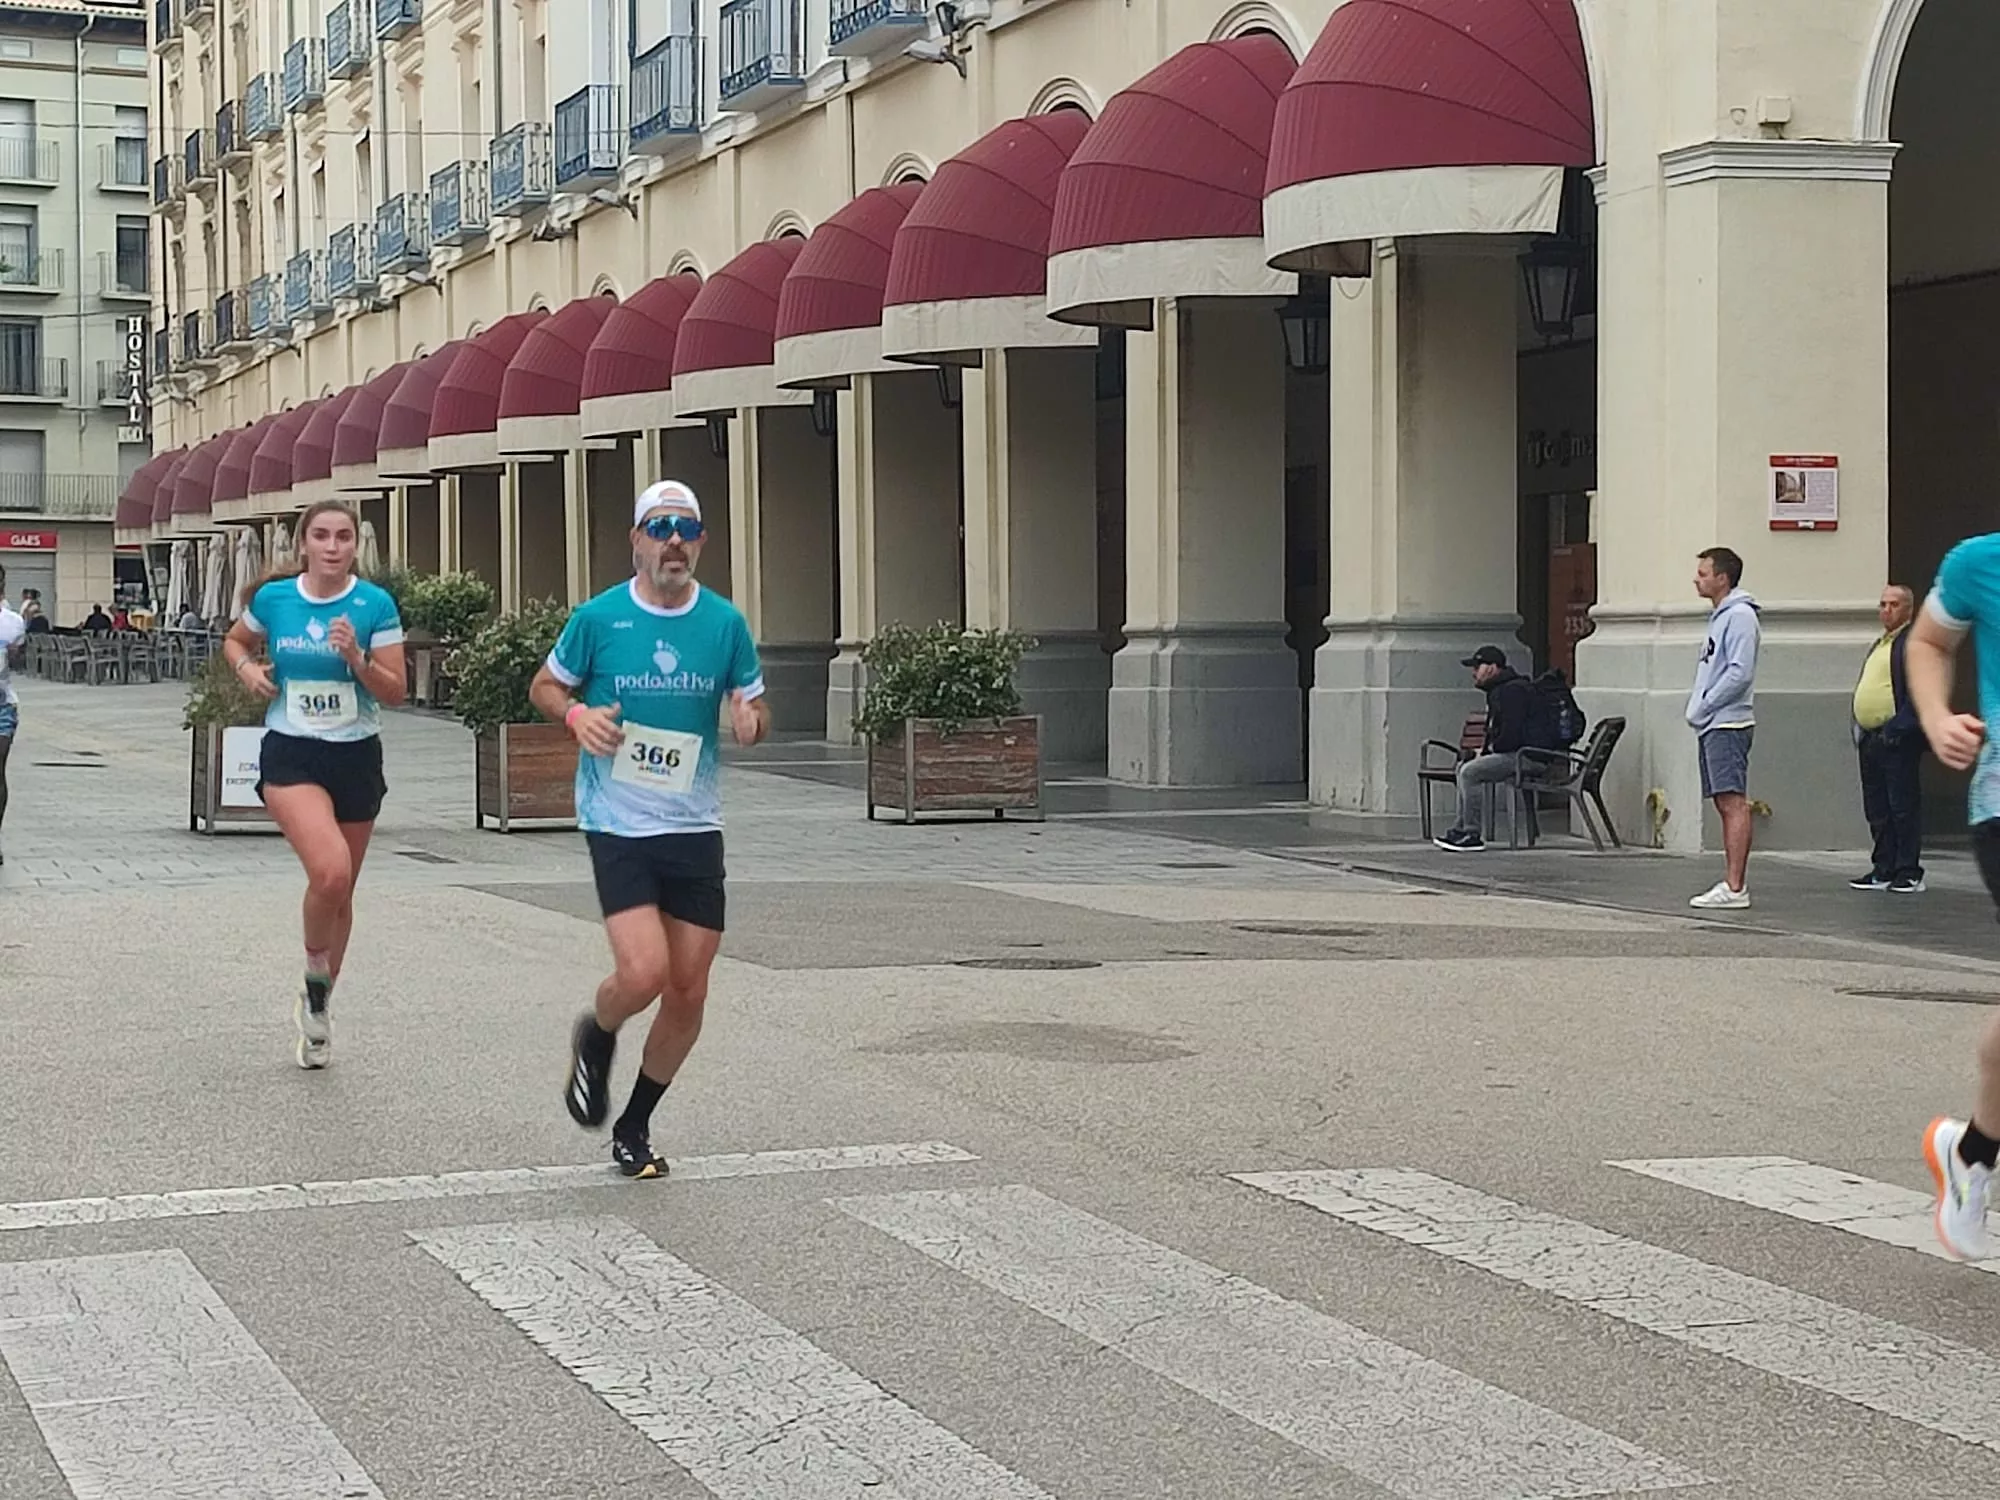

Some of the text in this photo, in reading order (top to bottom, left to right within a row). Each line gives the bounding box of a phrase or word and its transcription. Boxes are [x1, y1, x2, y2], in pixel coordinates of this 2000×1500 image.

[128, 316, 143, 422] HOSTAL
[11, 535, 40, 546] GAES
[614, 671, 716, 695] podoactiva
[299, 693, 341, 711] 368
[631, 741, 681, 768] 366
